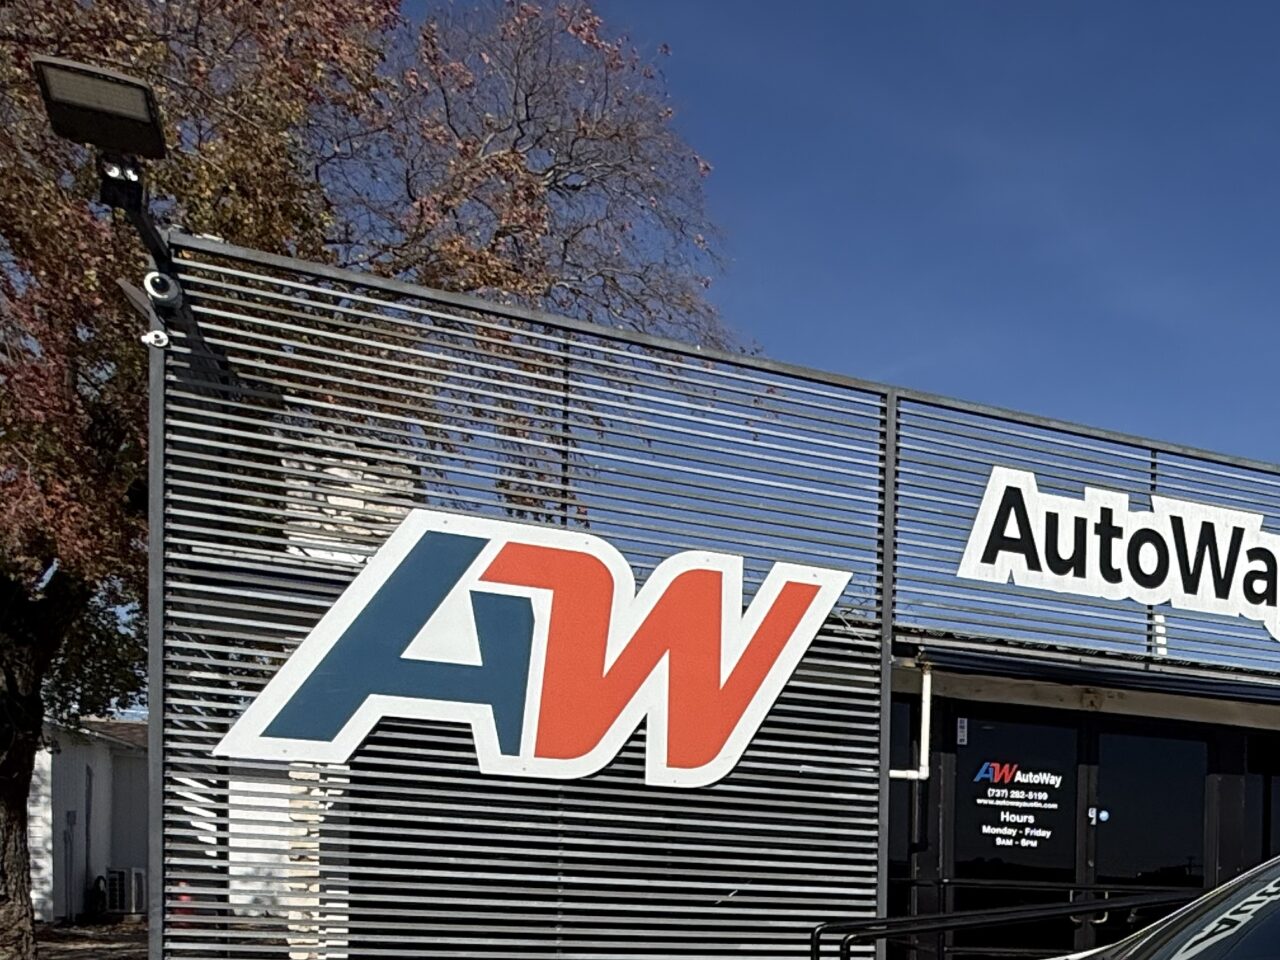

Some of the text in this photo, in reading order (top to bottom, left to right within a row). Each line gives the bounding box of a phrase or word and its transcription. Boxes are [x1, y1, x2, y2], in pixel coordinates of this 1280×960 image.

[260, 529, 822, 770] AW
[972, 761, 1063, 789] AW AutoWay
[1001, 811, 1035, 823] Hours
[982, 825, 1017, 837] Monday
[1024, 827, 1052, 839] Friday
